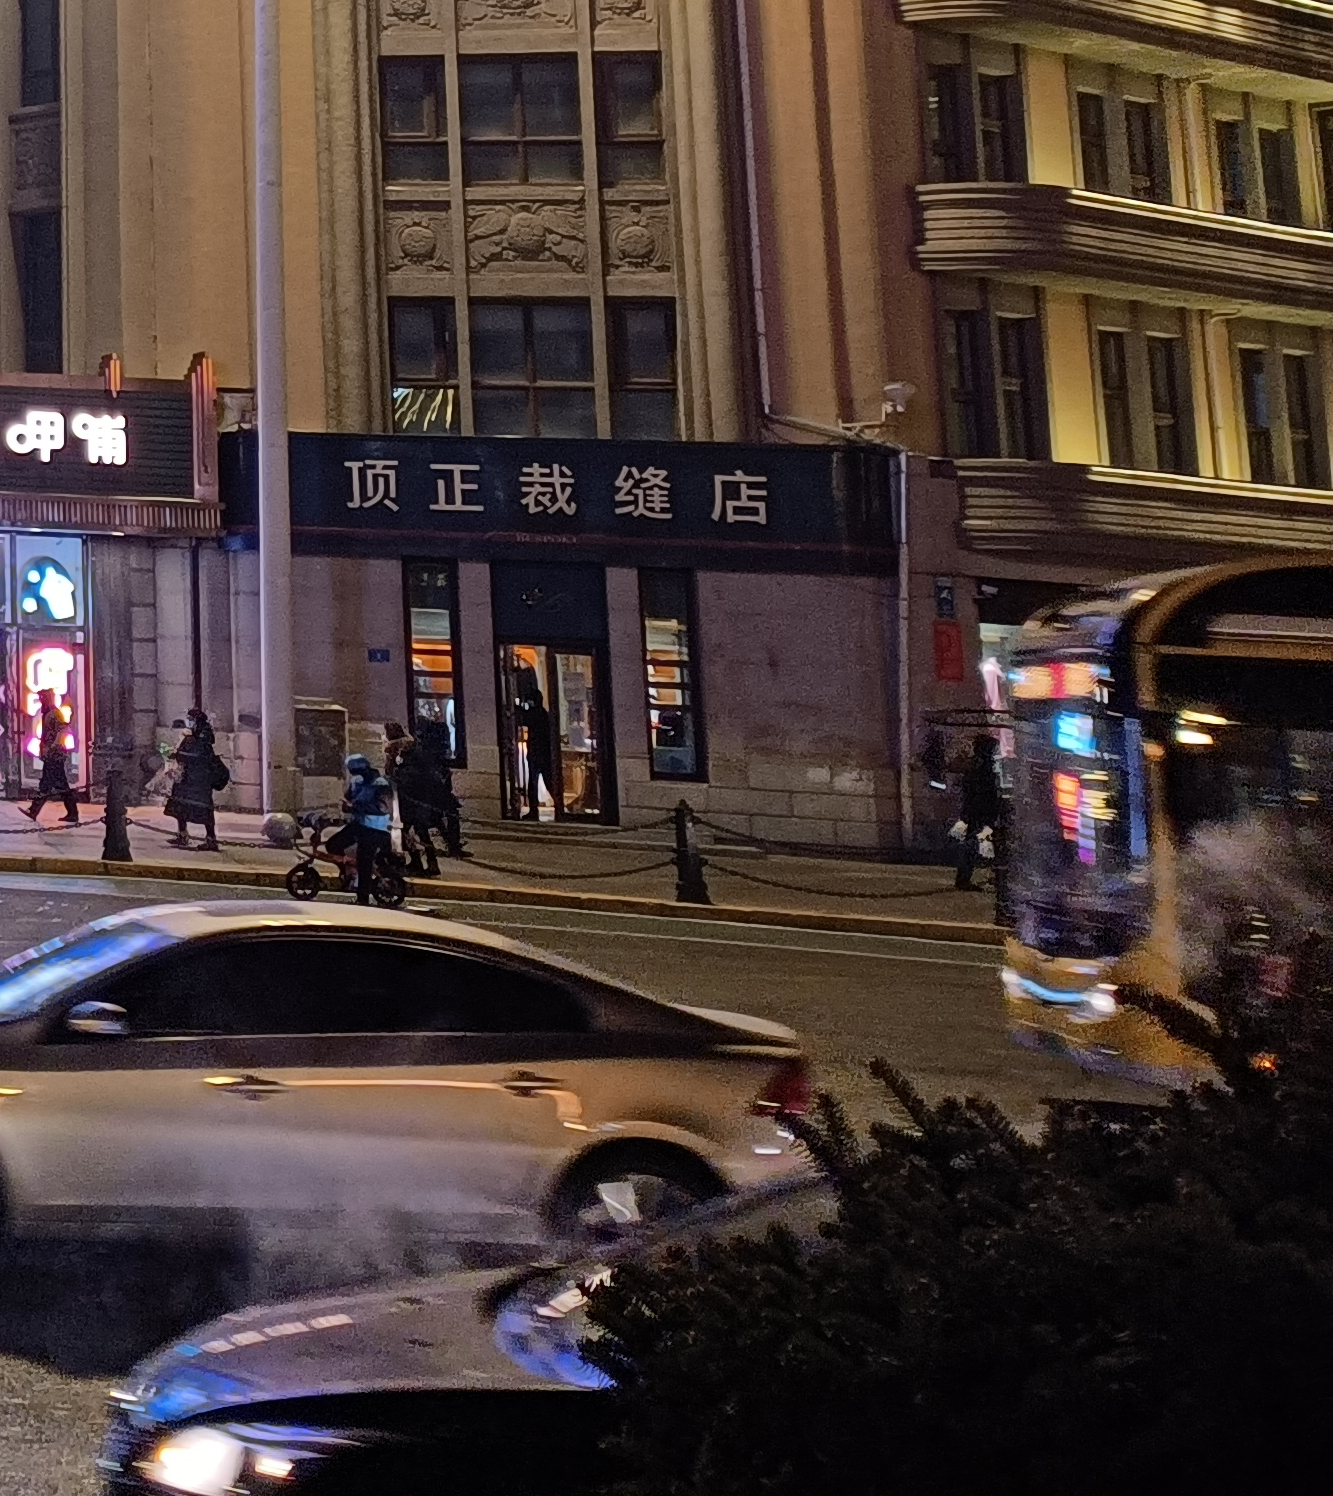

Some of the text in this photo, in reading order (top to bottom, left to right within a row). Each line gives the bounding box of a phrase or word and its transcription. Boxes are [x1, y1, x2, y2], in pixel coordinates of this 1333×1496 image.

[344, 458, 771, 526] 顶正裁缝店
